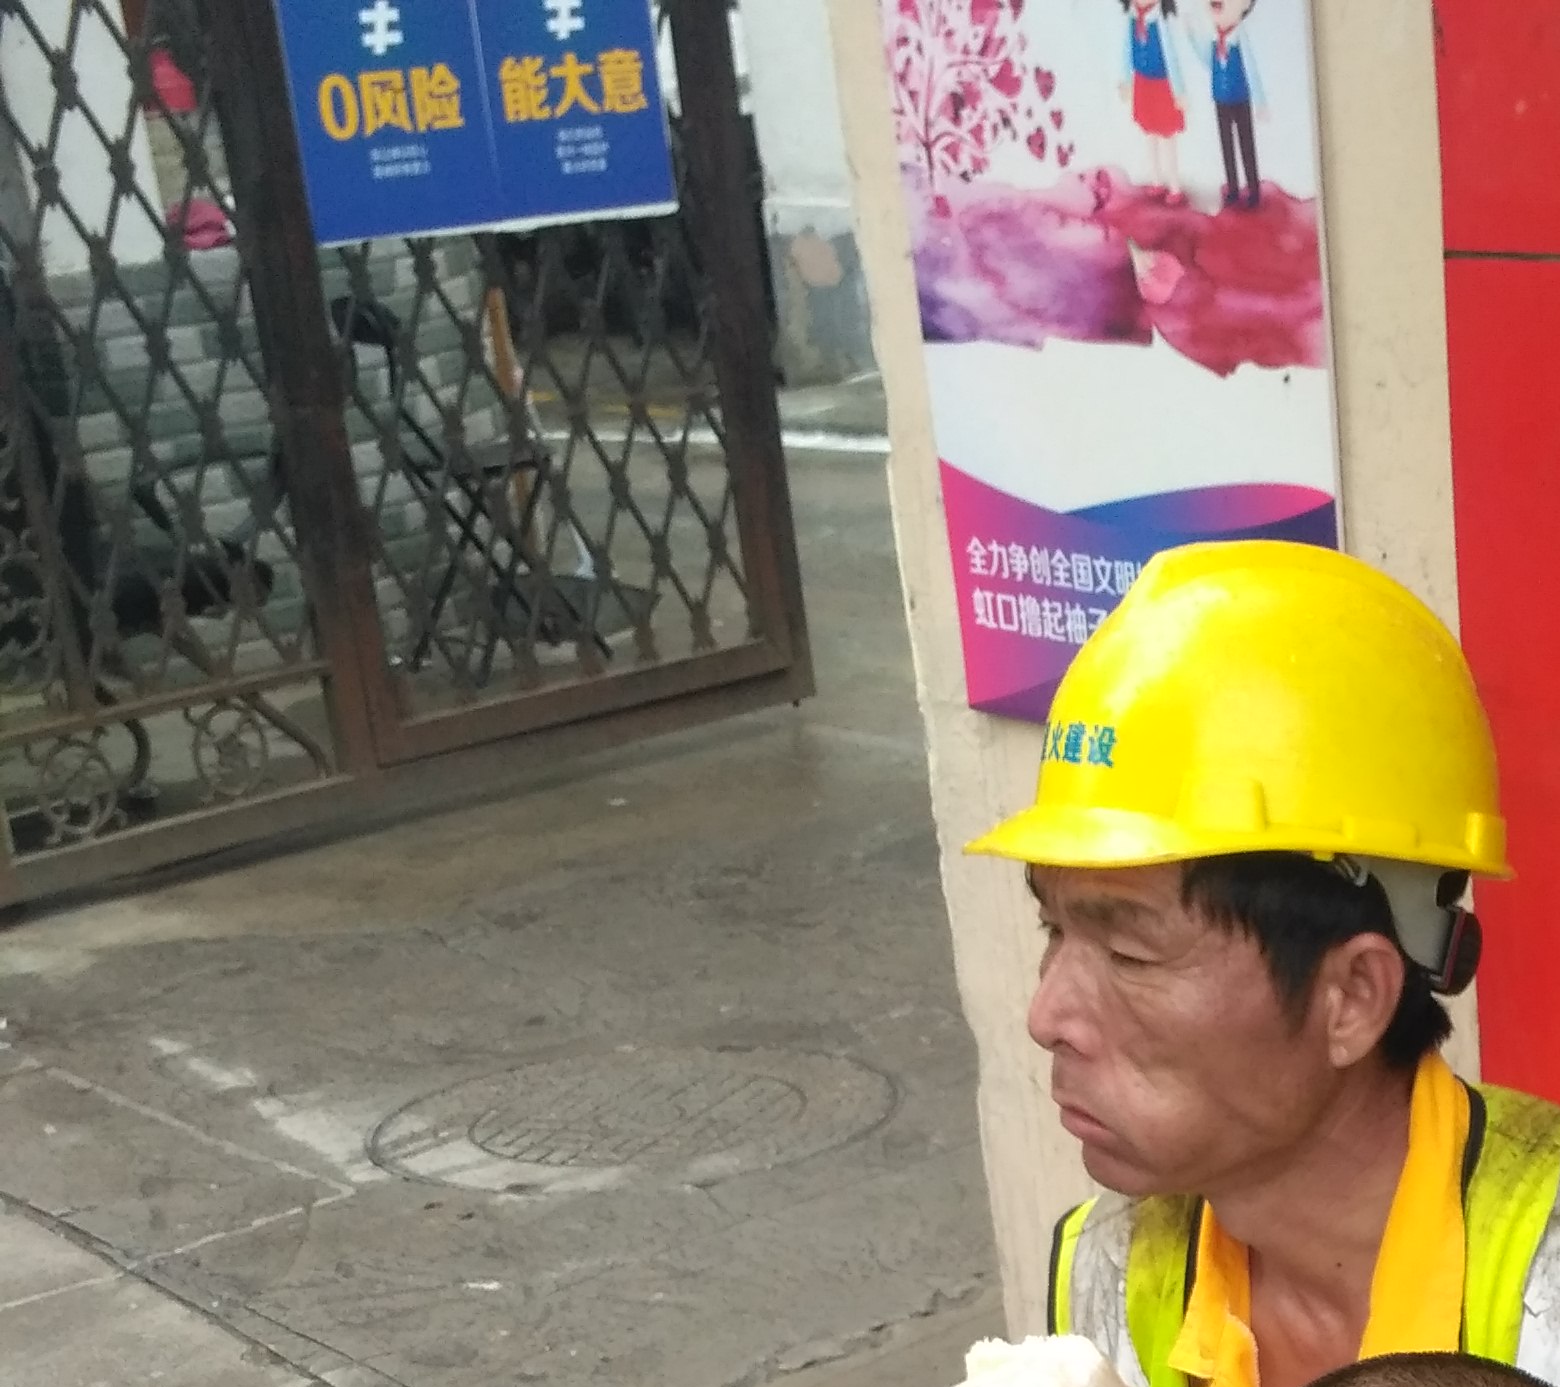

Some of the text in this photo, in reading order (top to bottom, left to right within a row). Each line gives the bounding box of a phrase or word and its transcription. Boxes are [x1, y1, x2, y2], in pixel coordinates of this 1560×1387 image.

[317, 62, 465, 141] 0风险
[498, 48, 649, 123] 能大意
[966, 535, 1142, 597] 全力争创全国文明
[1041, 720, 1117, 768] 火建设
